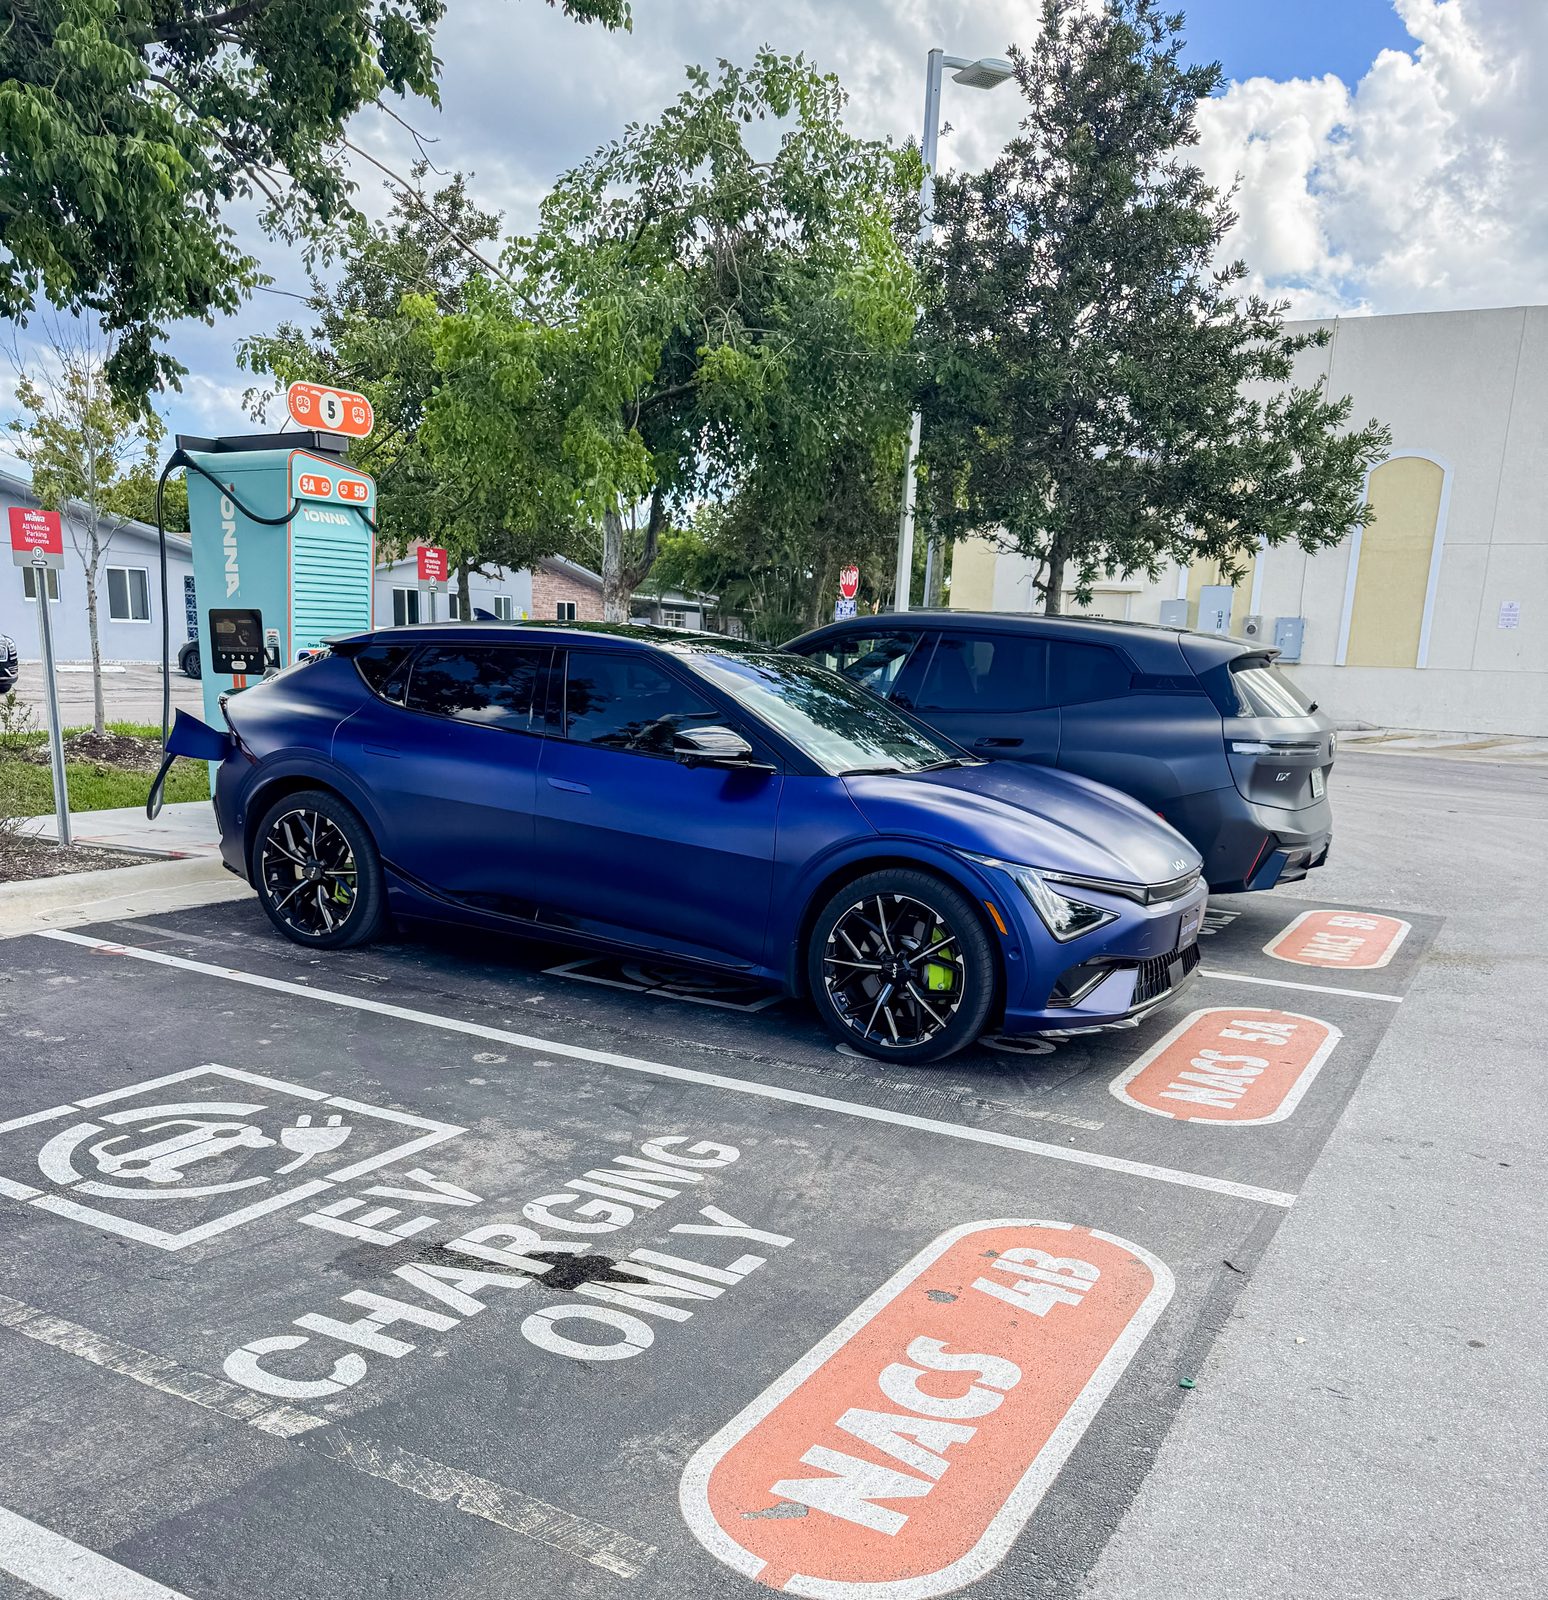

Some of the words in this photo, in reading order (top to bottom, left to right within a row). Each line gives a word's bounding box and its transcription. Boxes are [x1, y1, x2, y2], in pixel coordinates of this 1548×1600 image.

[328, 400, 336, 420] 5
[302, 478, 316, 492] 5A
[354, 486, 365, 498] 5B
[24, 512, 46, 522] Wawa
[26, 530, 48, 539] Parking
[841, 570, 857, 586] STOP
[1297, 932, 1366, 962] NACS
[1159, 1049, 1270, 1109] NACS
[1218, 1020, 1298, 1046] 5A
[298, 1168, 485, 1246] EV
[222, 1135, 740, 1399] CHARGING
[520, 1204, 796, 1361] ONLY
[769, 1336, 1022, 1536] NACS
[970, 1246, 1102, 1318] 4B
